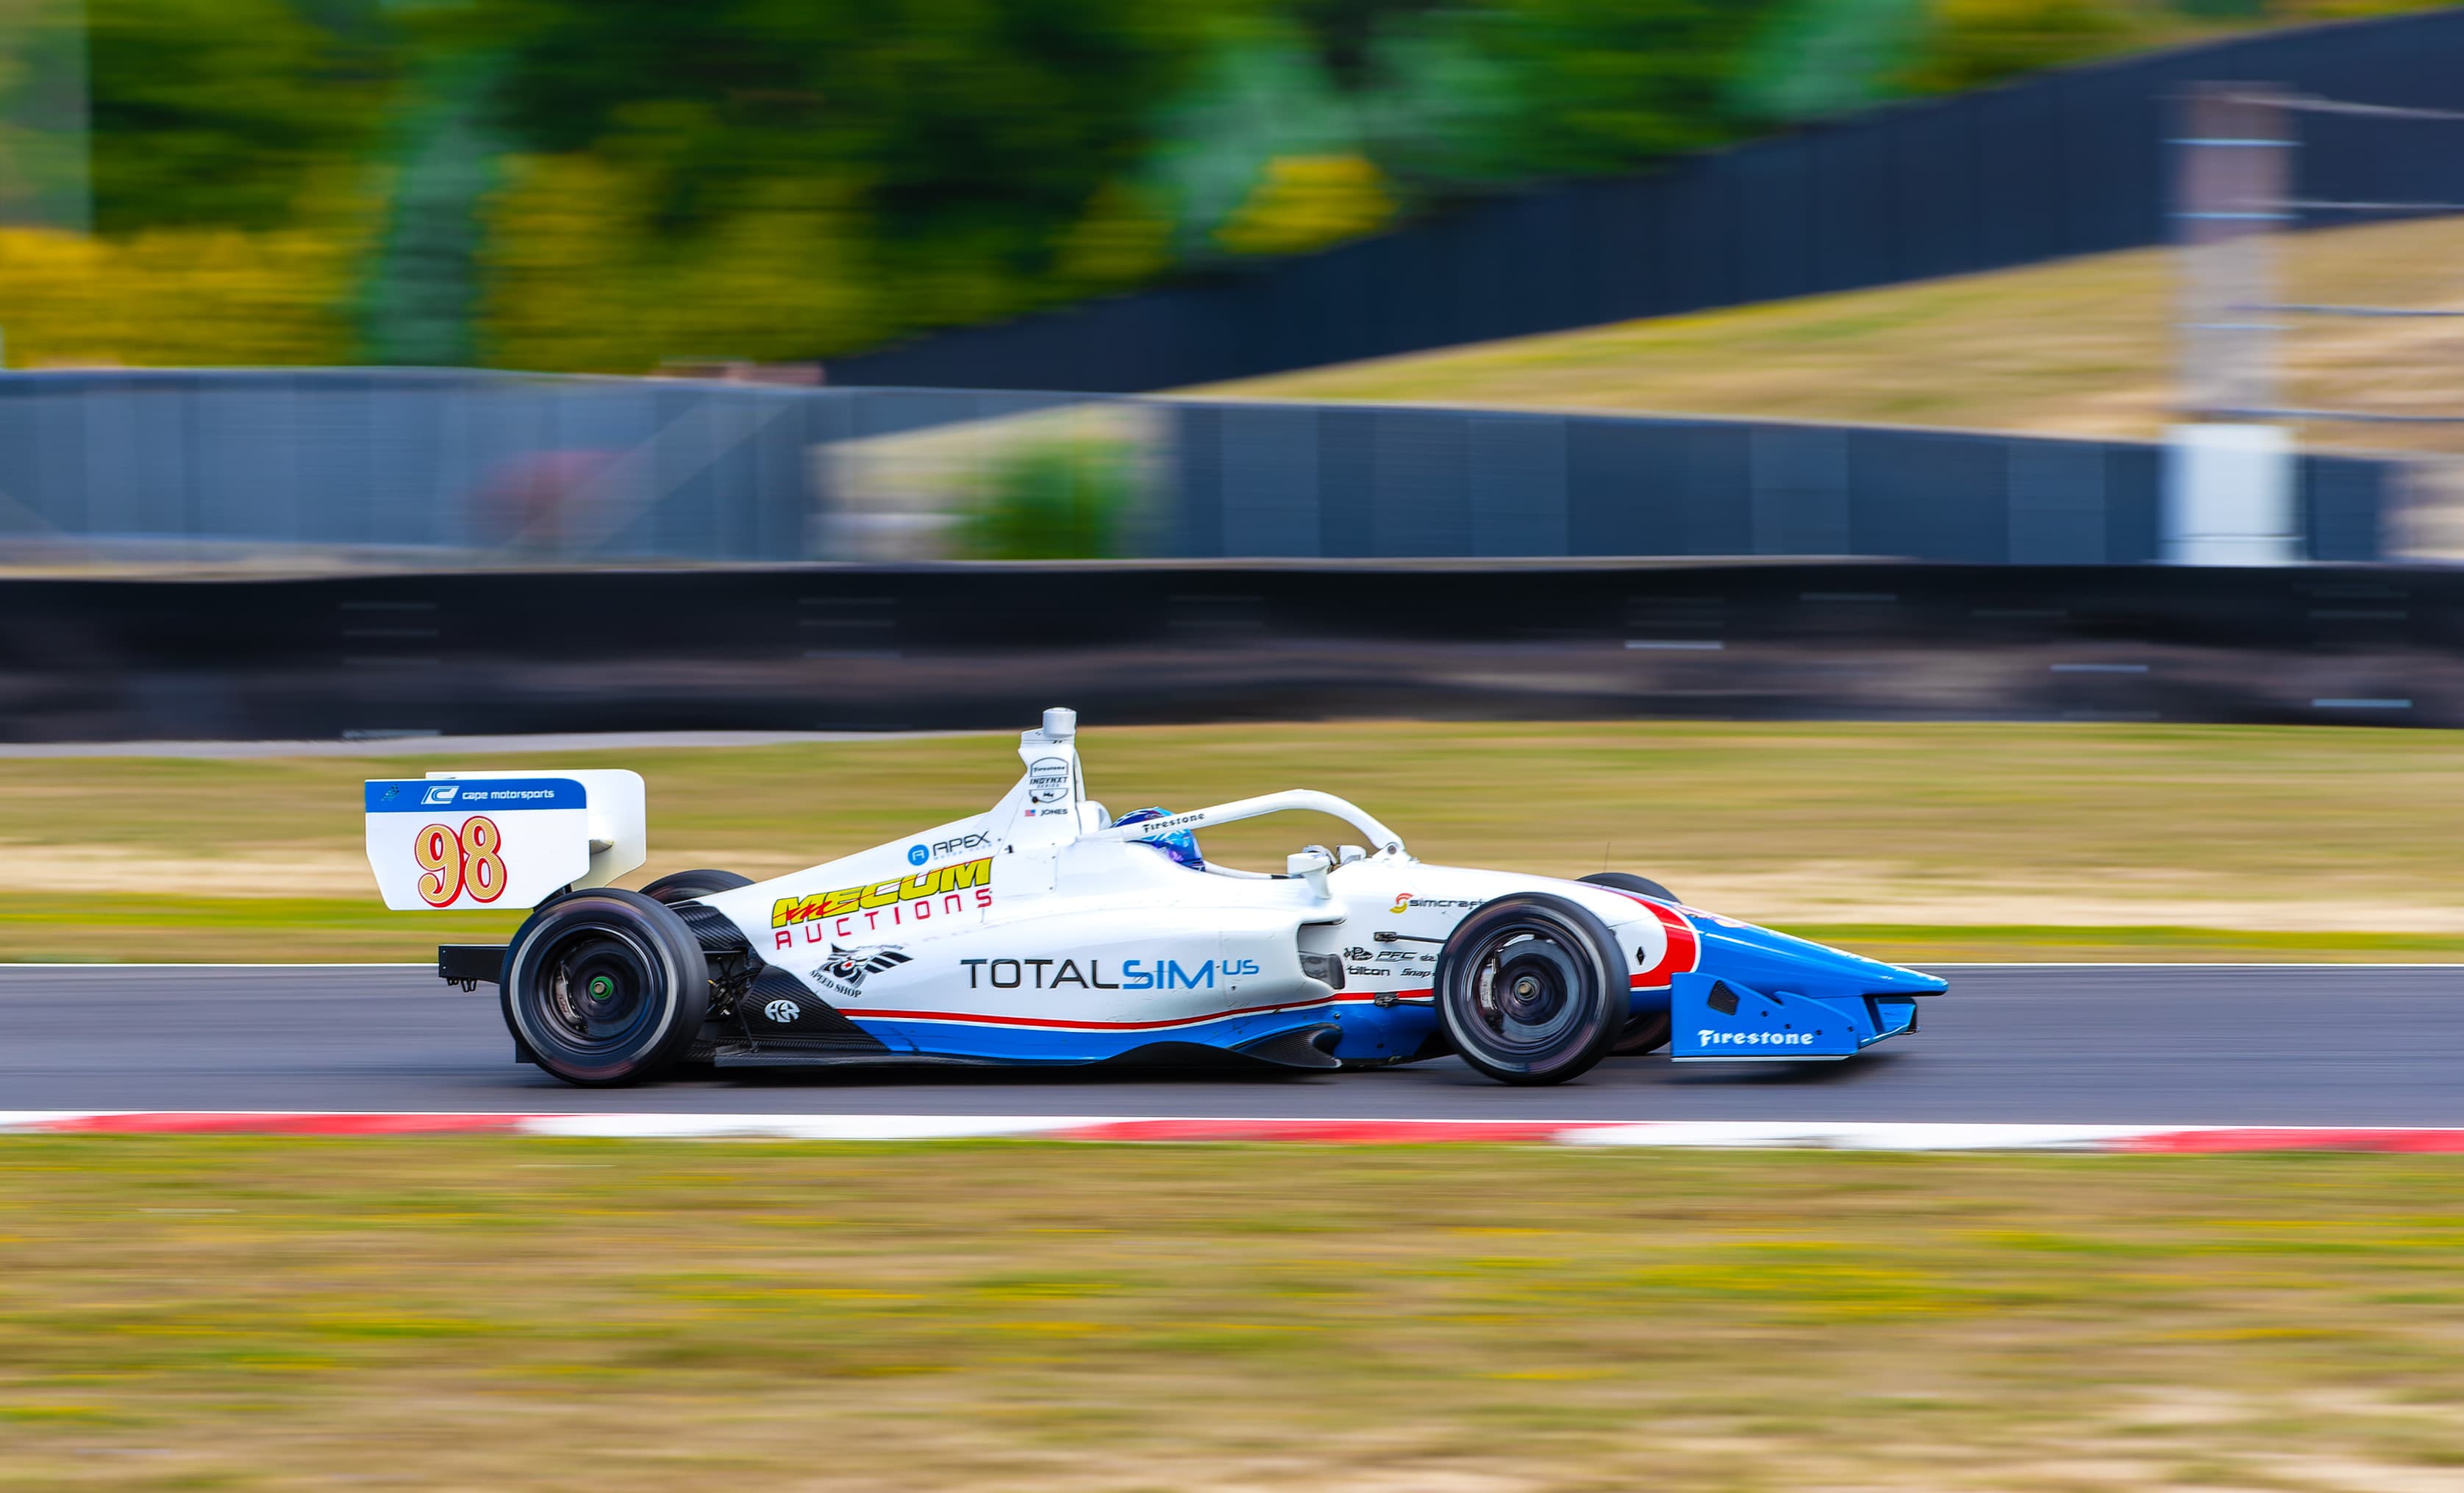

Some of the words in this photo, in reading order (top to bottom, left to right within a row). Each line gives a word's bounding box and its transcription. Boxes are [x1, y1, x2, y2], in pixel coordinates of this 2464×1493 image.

[462, 792, 488, 801] cape
[490, 790, 554, 800] motorsports
[1142, 813, 1205, 833] Firestone
[933, 830, 990, 856] APEX
[414, 816, 507, 908] 98
[772, 857, 993, 928] MECUM
[775, 888, 993, 949] AUCTIONS
[810, 970, 834, 988] SPEED
[835, 983, 862, 998] SHOP
[1697, 1030, 1814, 1047] Firestone
